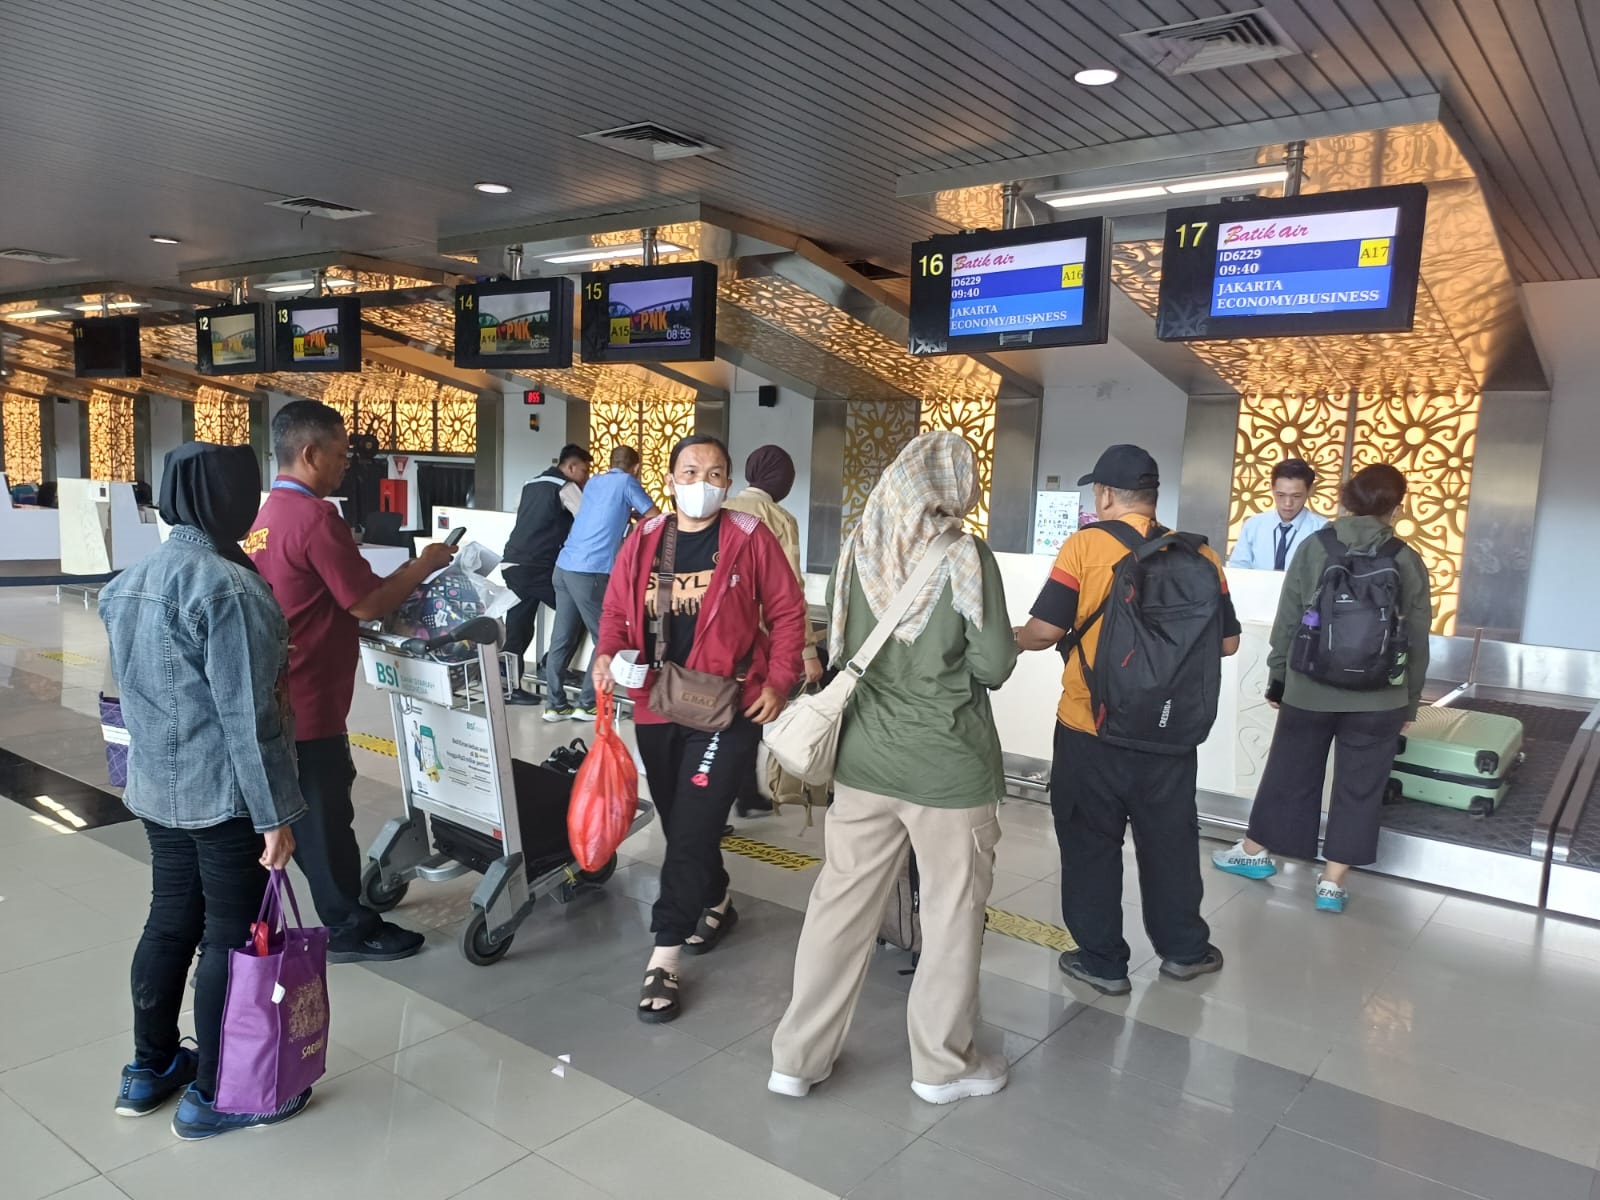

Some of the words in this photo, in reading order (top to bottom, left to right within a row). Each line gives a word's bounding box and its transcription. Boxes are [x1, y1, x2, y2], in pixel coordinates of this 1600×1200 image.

[1175, 222, 1208, 248] 17
[1223, 223, 1277, 246] Batik
[1278, 224, 1309, 239] air
[1219, 249, 1261, 262] ID6229
[1360, 247, 1389, 259] A17
[919, 253, 944, 277] 16
[953, 252, 991, 272] Batik
[993, 253, 1016, 267] air
[1219, 263, 1260, 276] 09:40
[951, 276, 982, 287] ID6229
[1063, 270, 1084, 281] A16
[585, 283, 602, 300] 15
[951, 287, 980, 299] 09:40
[1217, 280, 1283, 296] JAKARTA
[458, 295, 473, 310] 14
[1217, 290, 1380, 309] ECONOMY/BUSINESS
[277, 309, 289, 323] 13
[951, 304, 998, 319] JAKARTA
[198, 317, 209, 330] 12
[641, 311, 669, 331] PNK
[951, 310, 1067, 330] ECONOMY/BUSINESS
[506, 320, 532, 340] PNK
[611, 326, 629, 337] A15
[666, 328, 691, 340] 08:55
[646, 573, 714, 590] SYL
[376, 661, 399, 688] BSI
[1159, 699, 1172, 728] CRESSIDA
